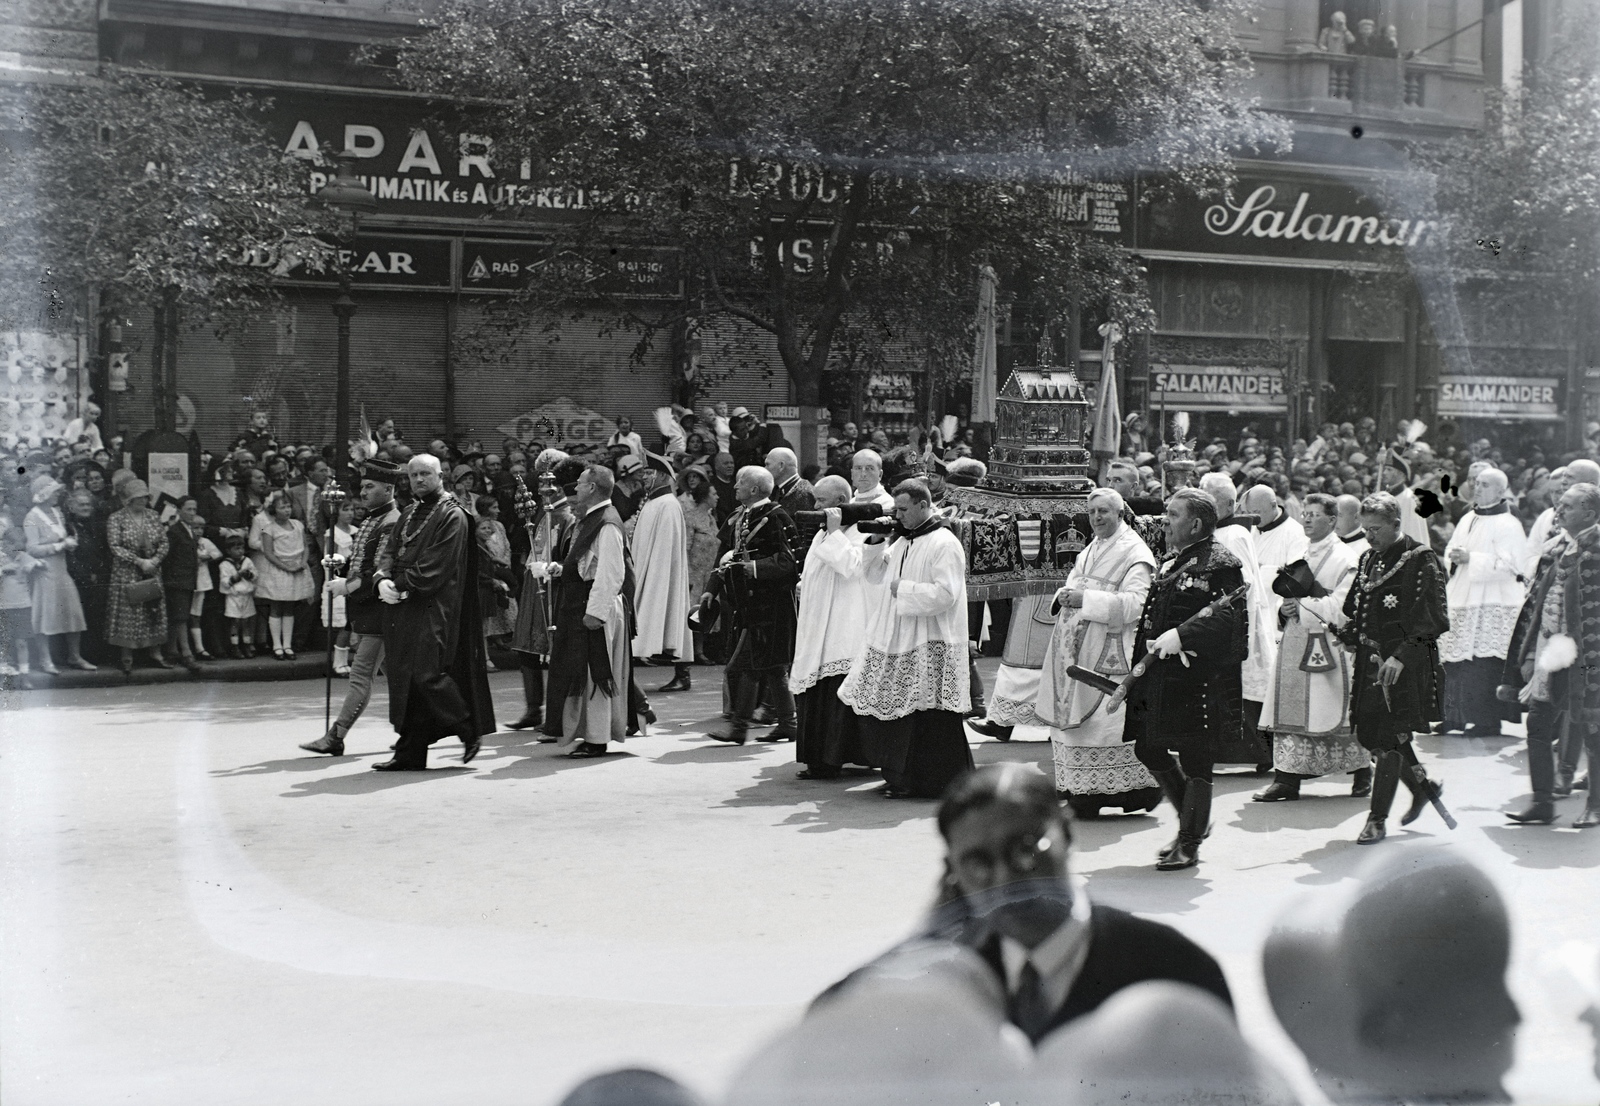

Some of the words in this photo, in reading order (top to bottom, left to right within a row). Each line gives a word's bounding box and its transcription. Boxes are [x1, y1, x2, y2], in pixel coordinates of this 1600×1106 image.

[309, 171, 451, 203] PUMATIK
[453, 187, 469, 203] ÉS
[1204, 185, 1439, 247] Salaman
[492, 262, 520, 274] RAD
[1155, 373, 1284, 394] SALAMANDER
[1442, 383, 1554, 403] SALAMANDER
